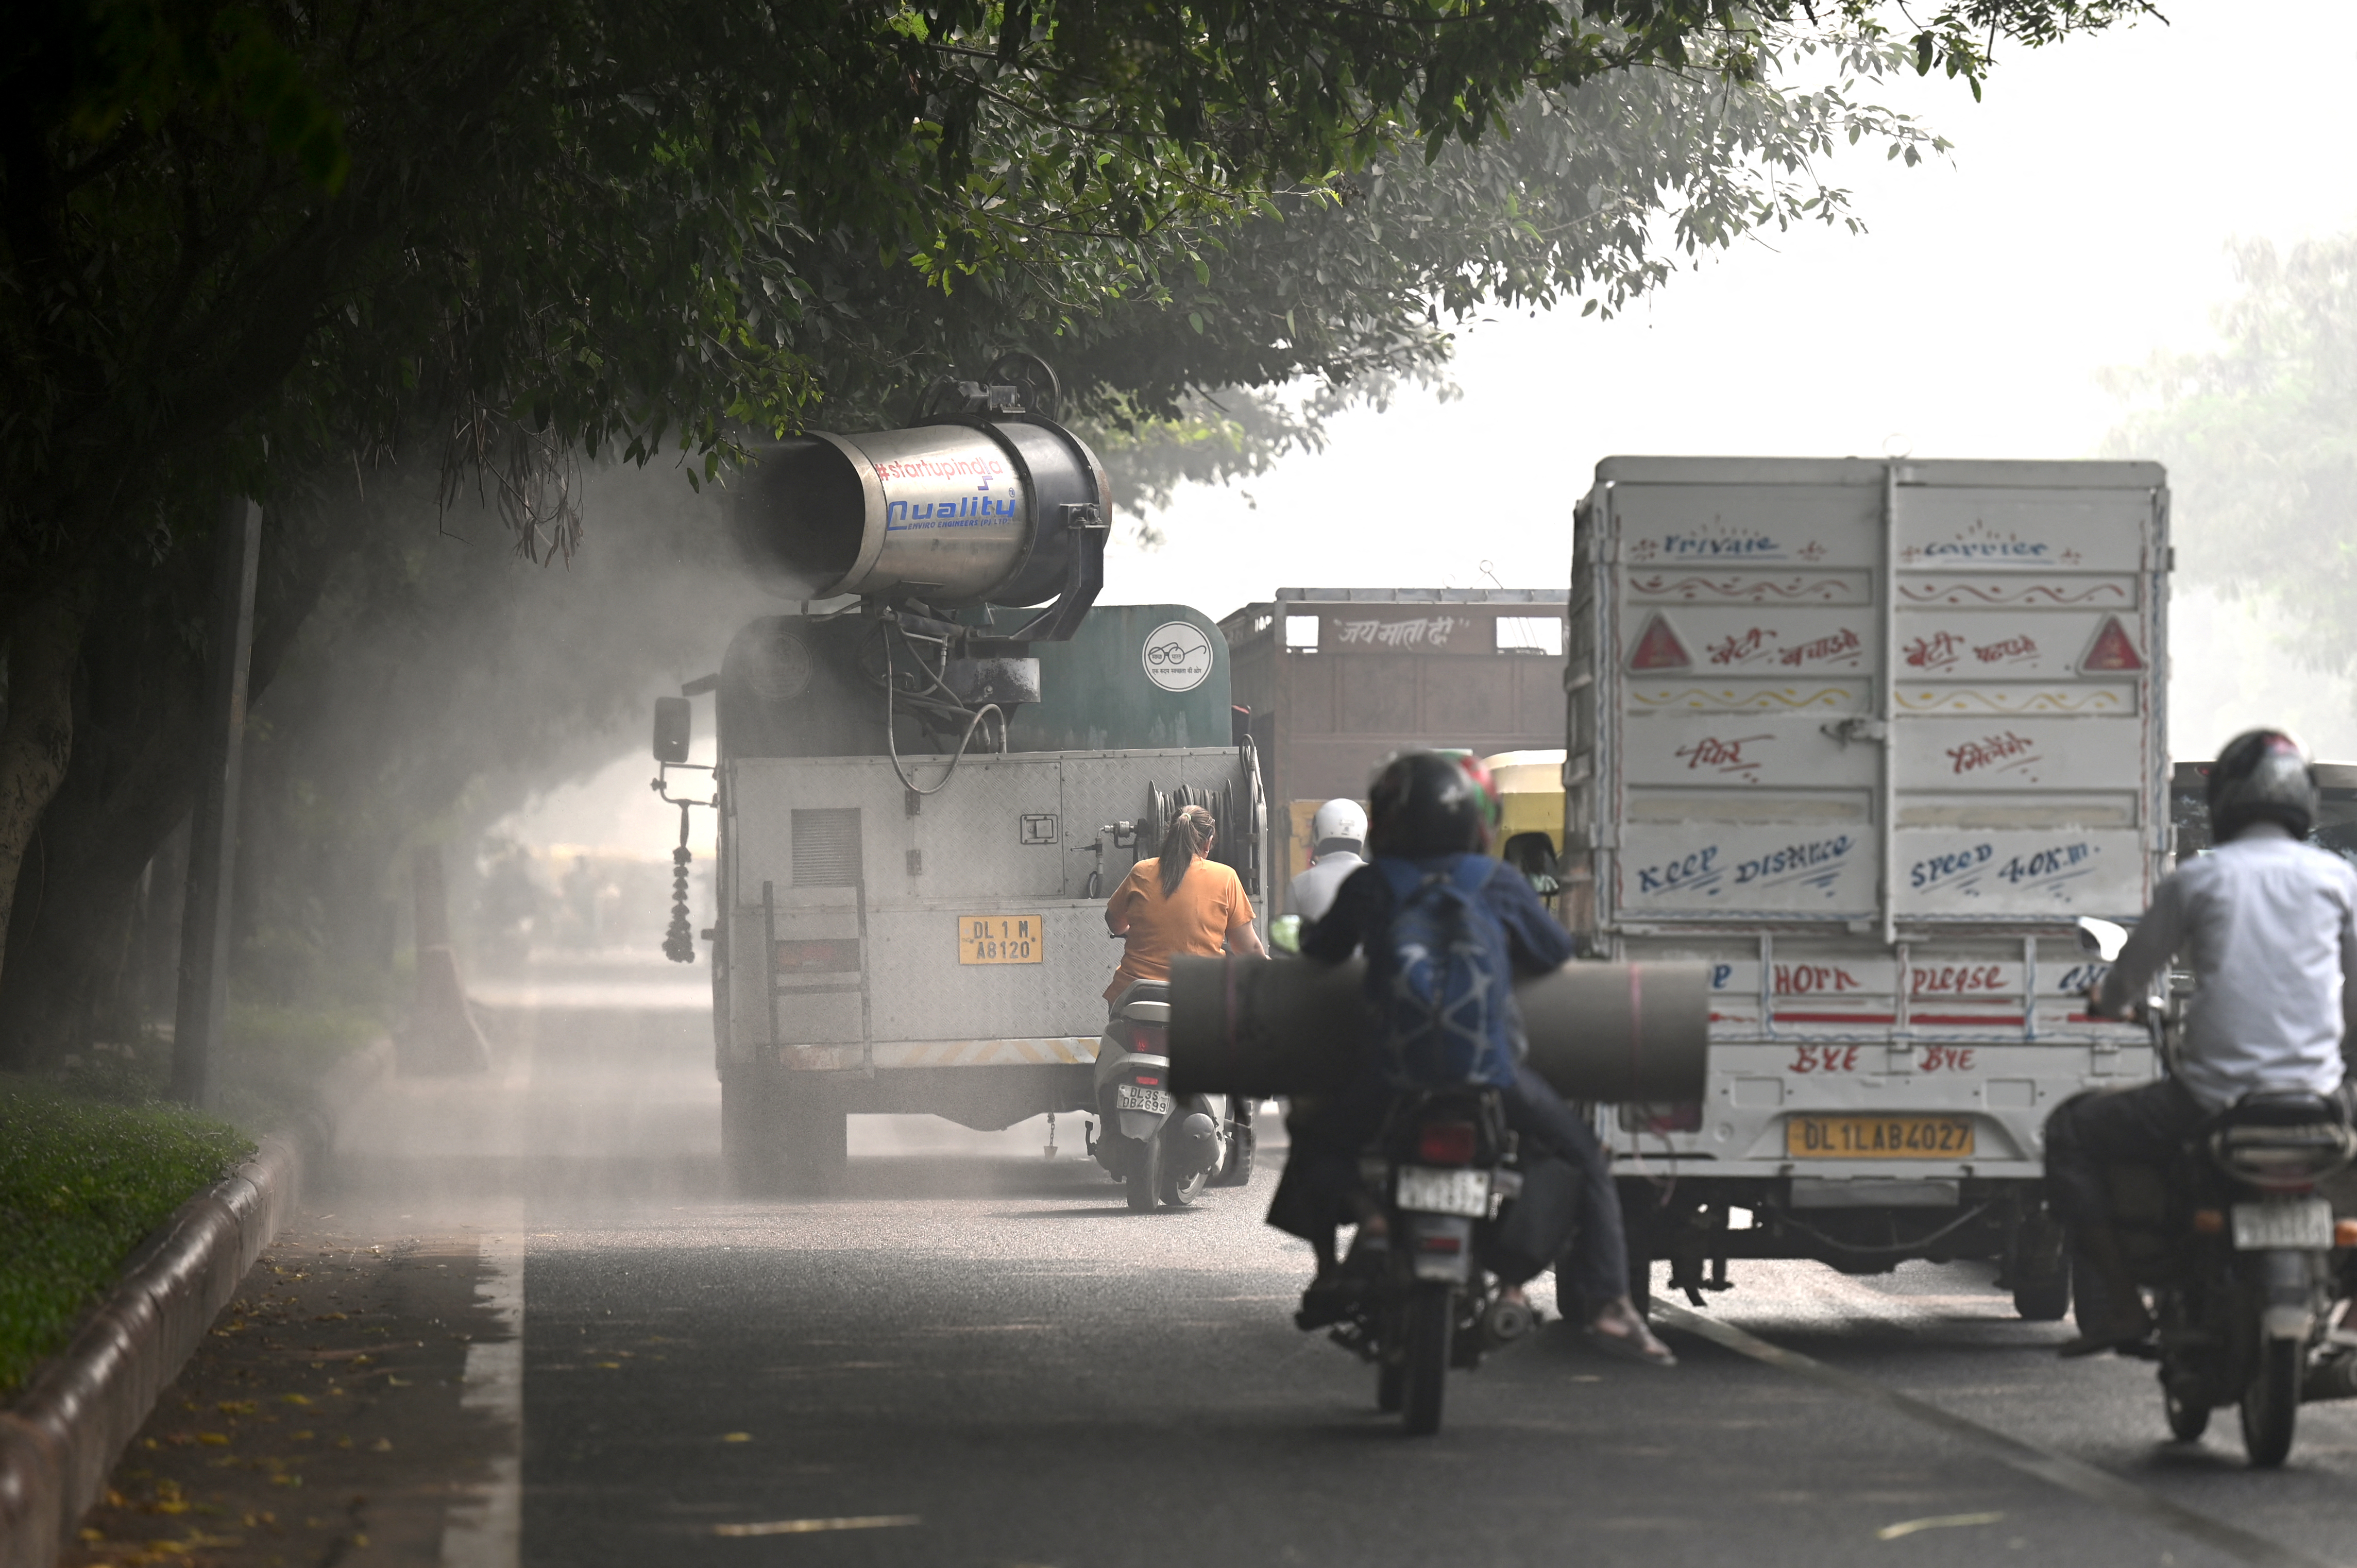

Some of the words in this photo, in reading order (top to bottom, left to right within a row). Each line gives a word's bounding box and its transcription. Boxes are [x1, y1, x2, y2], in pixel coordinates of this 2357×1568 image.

[887, 496, 1015, 531] Quality
[907, 521, 936, 530] ENVIRO
[937, 519, 978, 528] ENGINEERS
[1378, 618, 1428, 651] माता
[1706, 627, 1777, 664] बेटी
[1902, 631, 1964, 667] बेटी
[974, 921, 994, 939] DL
[1002, 921, 1008, 939] 1
[1019, 921, 1028, 938] M
[976, 941, 1030, 959] A8120
[1130, 1087, 1159, 1100] DL3S
[1123, 1097, 1166, 1113] DB4699
